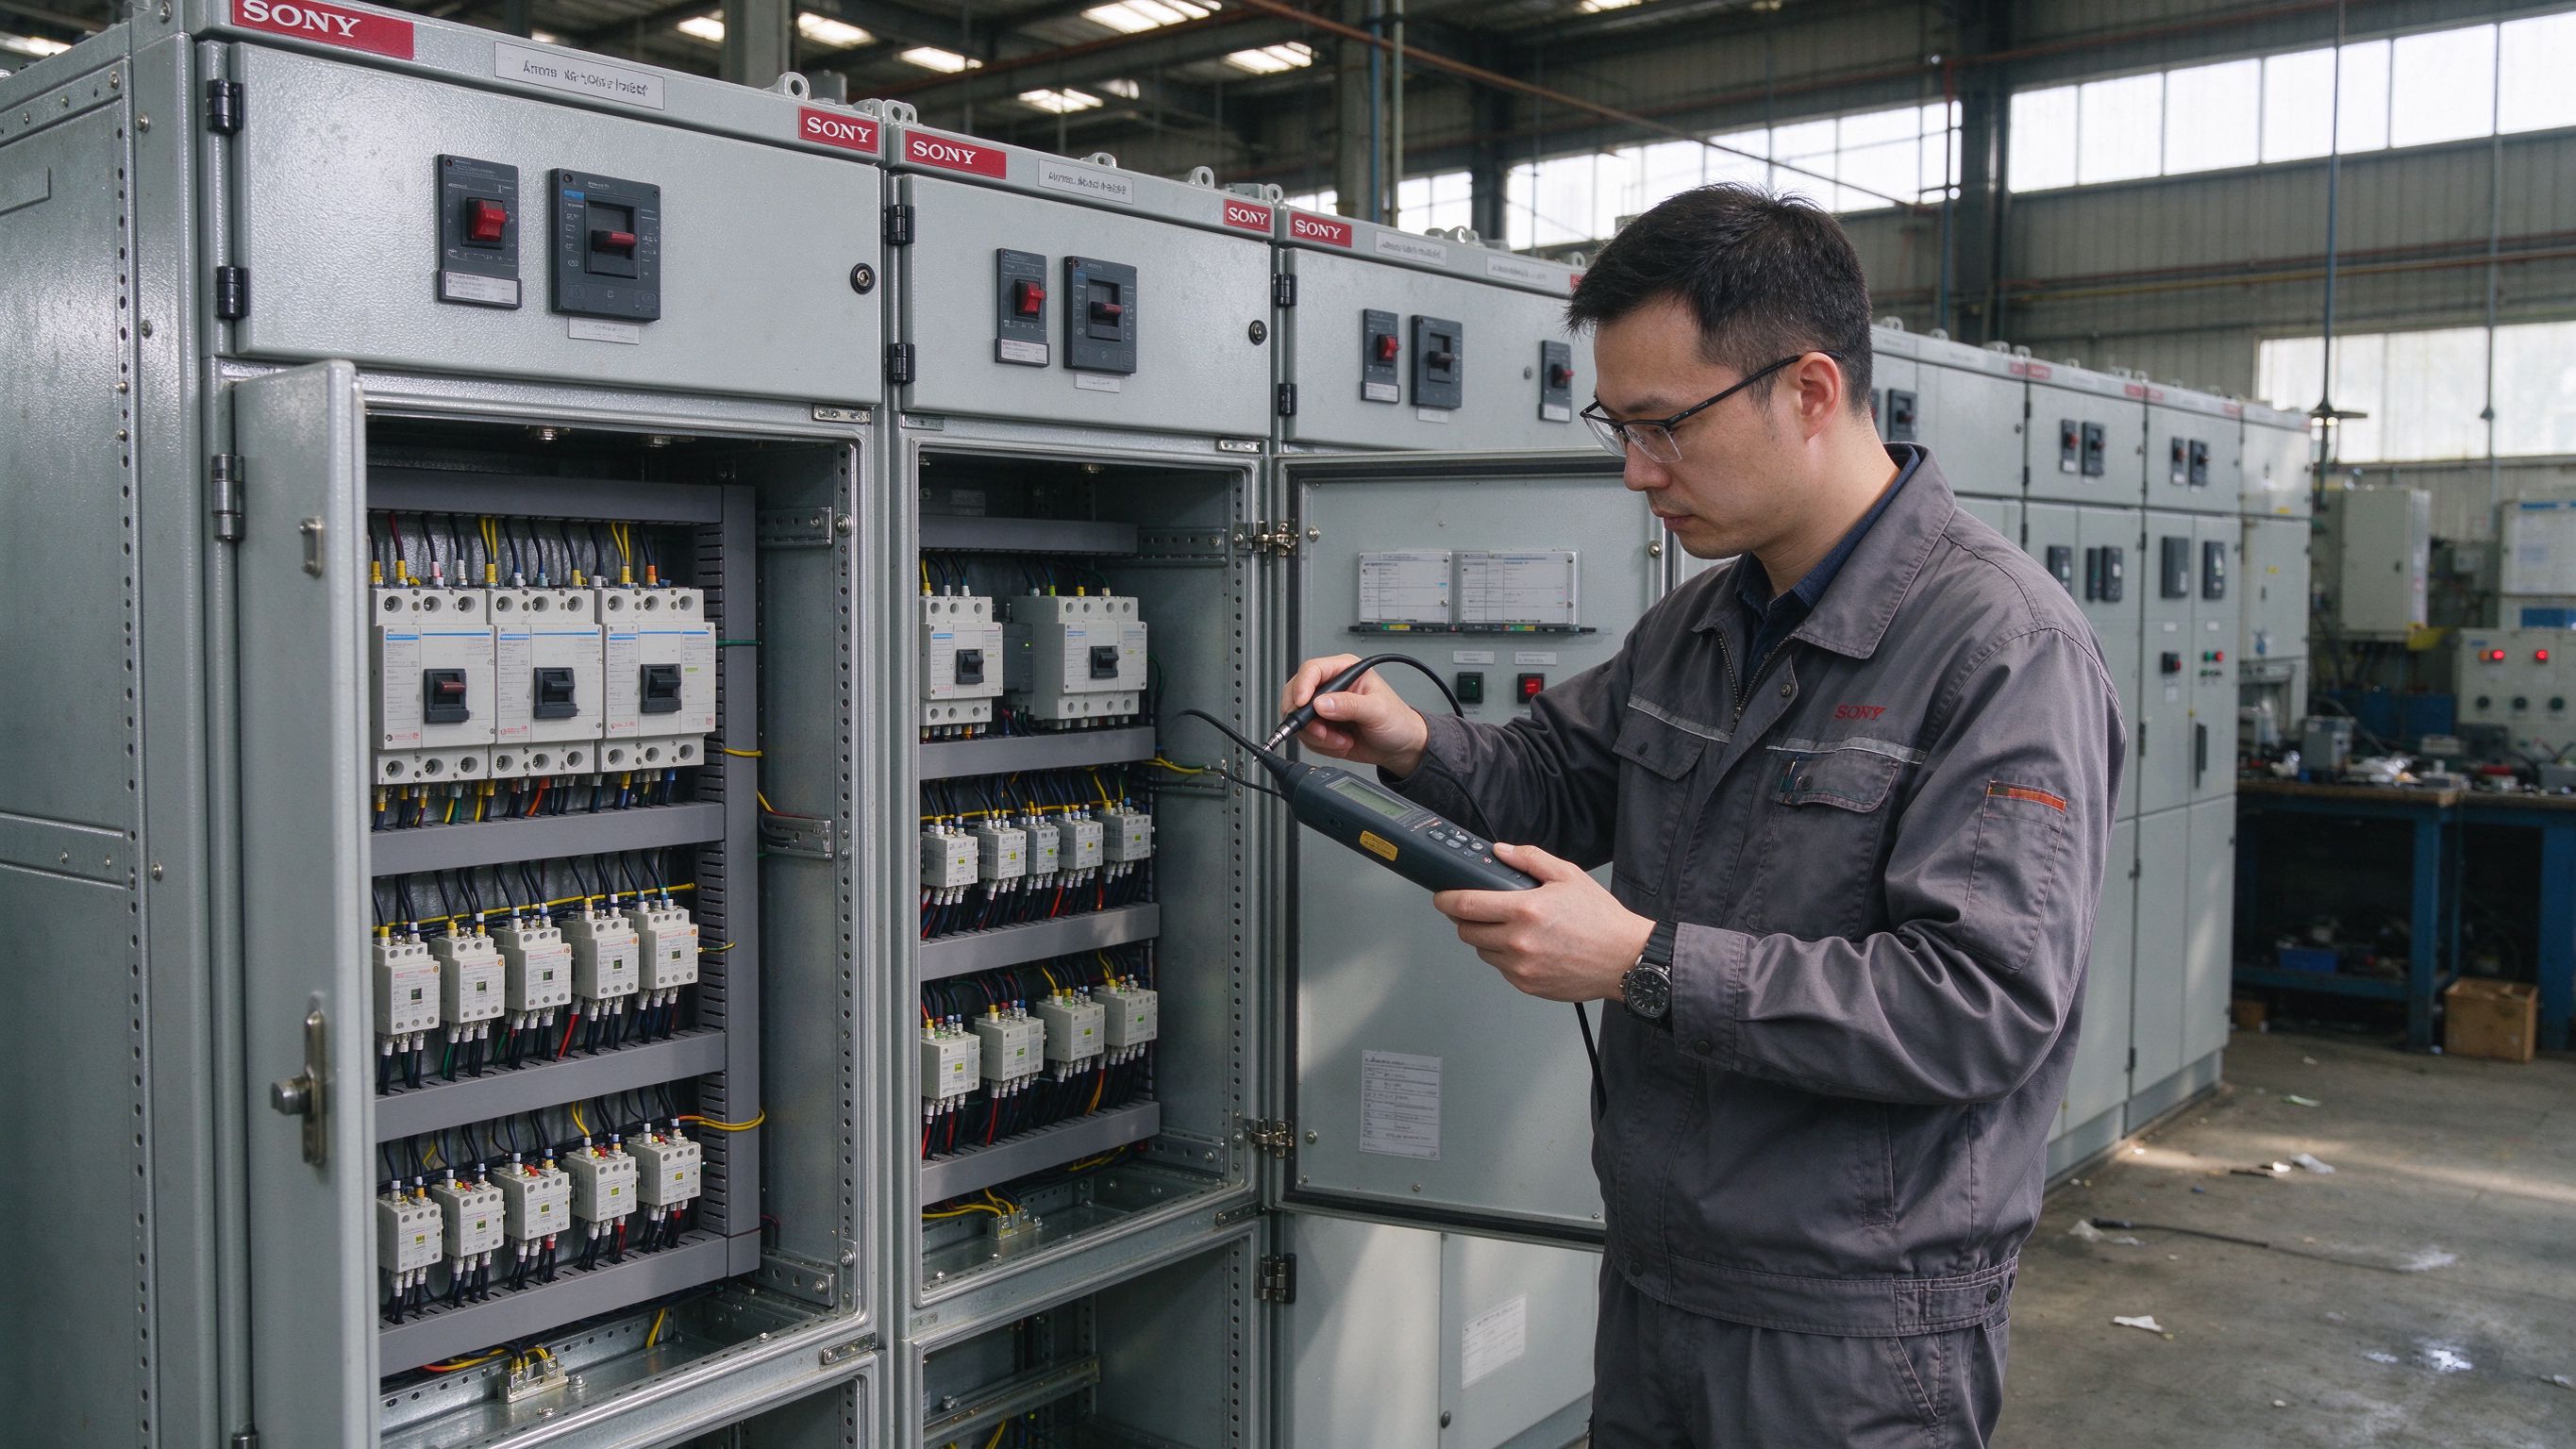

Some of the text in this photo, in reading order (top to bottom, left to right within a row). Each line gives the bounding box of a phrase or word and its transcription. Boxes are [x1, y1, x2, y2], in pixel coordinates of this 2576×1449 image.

[243, 0, 361, 38] SONY
[807, 117, 872, 142] SONY
[912, 141, 977, 165] SONY
[1228, 207, 1267, 225] SONY
[1295, 219, 1342, 240] SONY
[1834, 705, 1888, 721] SONY
